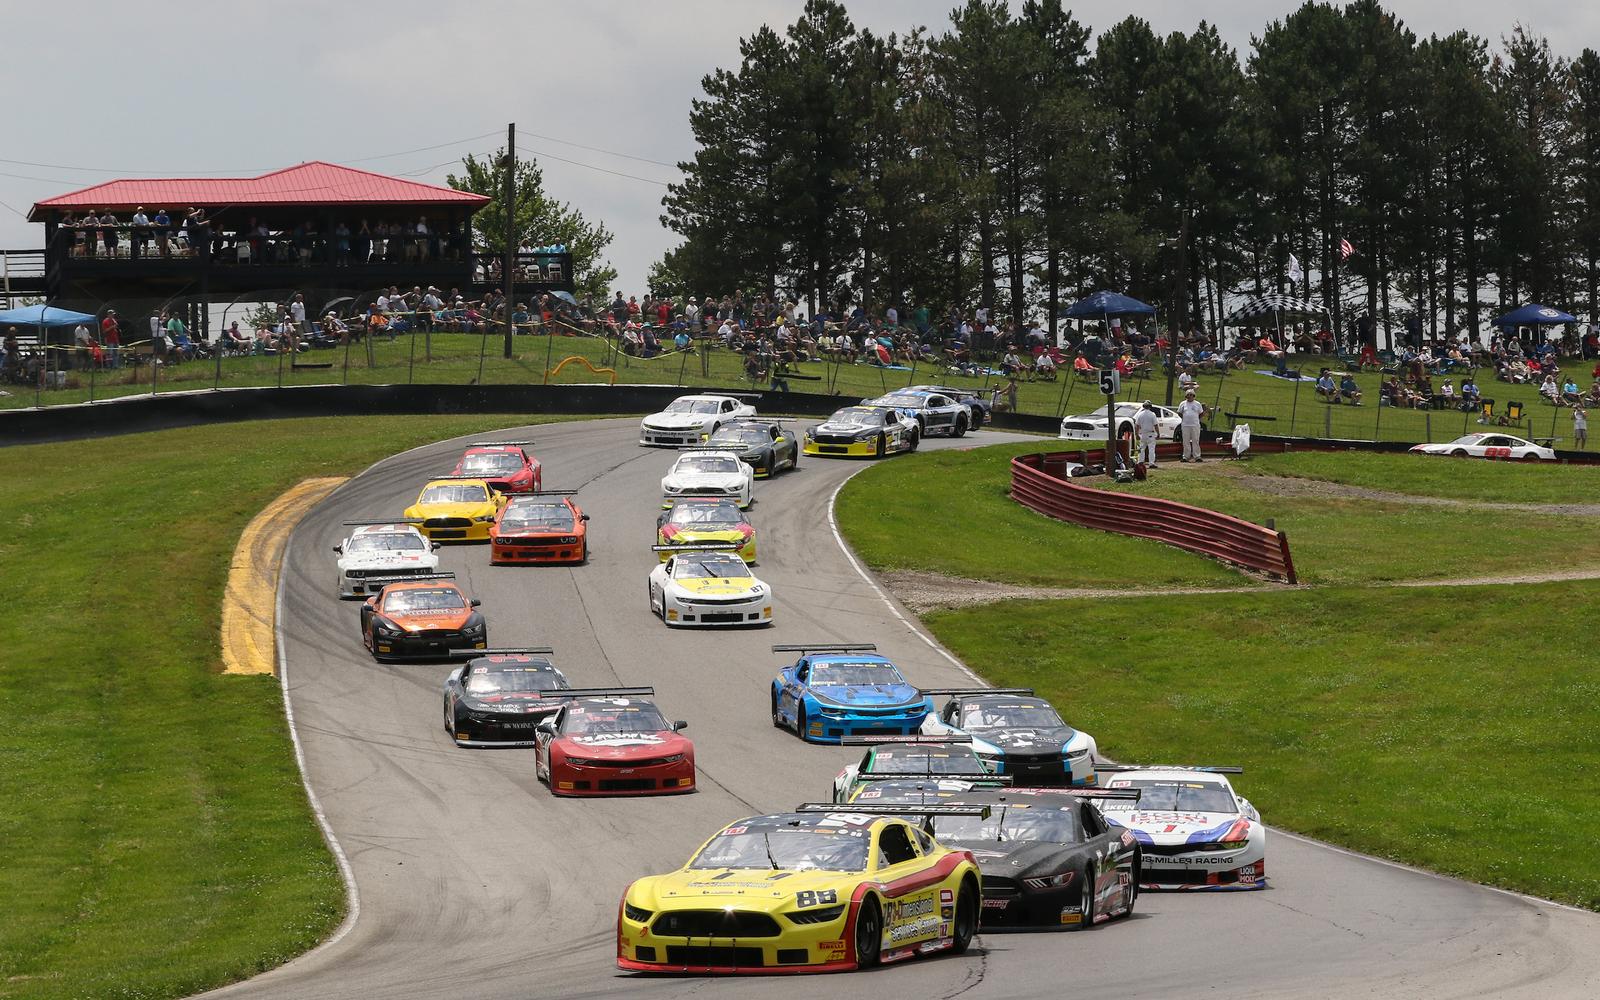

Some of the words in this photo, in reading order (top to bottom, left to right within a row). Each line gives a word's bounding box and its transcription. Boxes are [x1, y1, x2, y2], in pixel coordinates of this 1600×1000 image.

[1100, 370, 1114, 394] 5
[796, 889, 837, 908] 88
[890, 922, 919, 942] Services
[918, 916, 939, 936] Group
